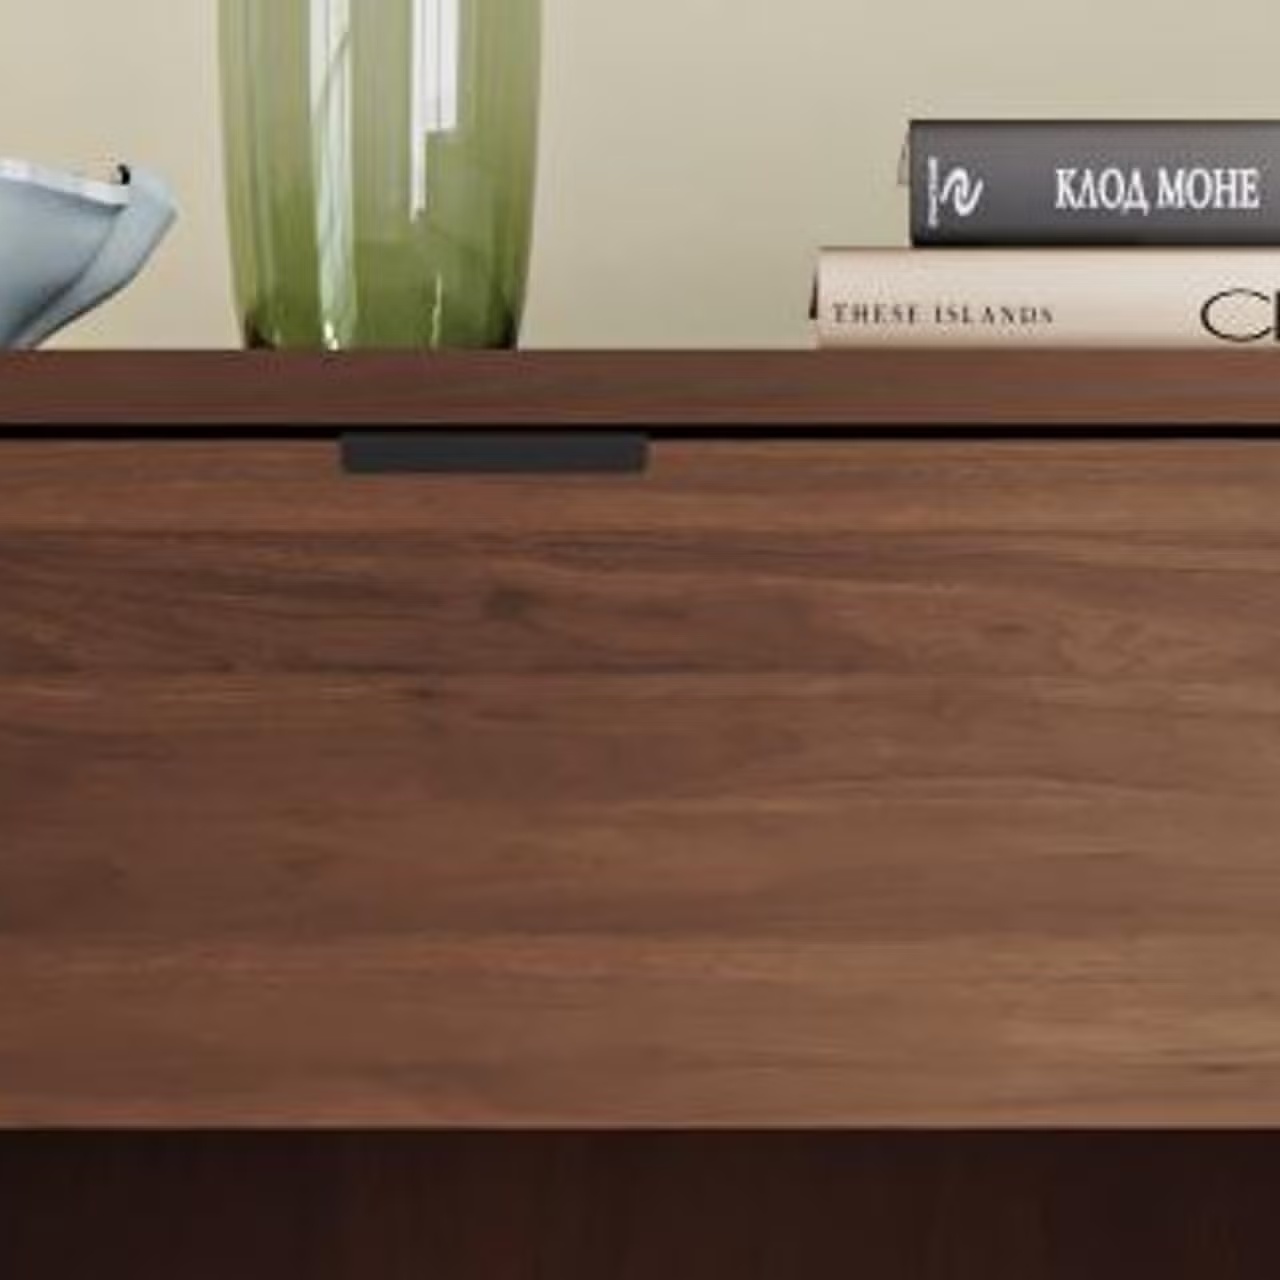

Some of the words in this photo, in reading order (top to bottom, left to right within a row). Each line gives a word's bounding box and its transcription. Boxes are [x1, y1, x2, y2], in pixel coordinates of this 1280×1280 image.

[1055, 167, 1150, 216] КЛОД
[1157, 167, 1260, 209] МОНЕ
[832, 302, 918, 325] THESE
[934, 304, 1055, 325] ISLANDS
